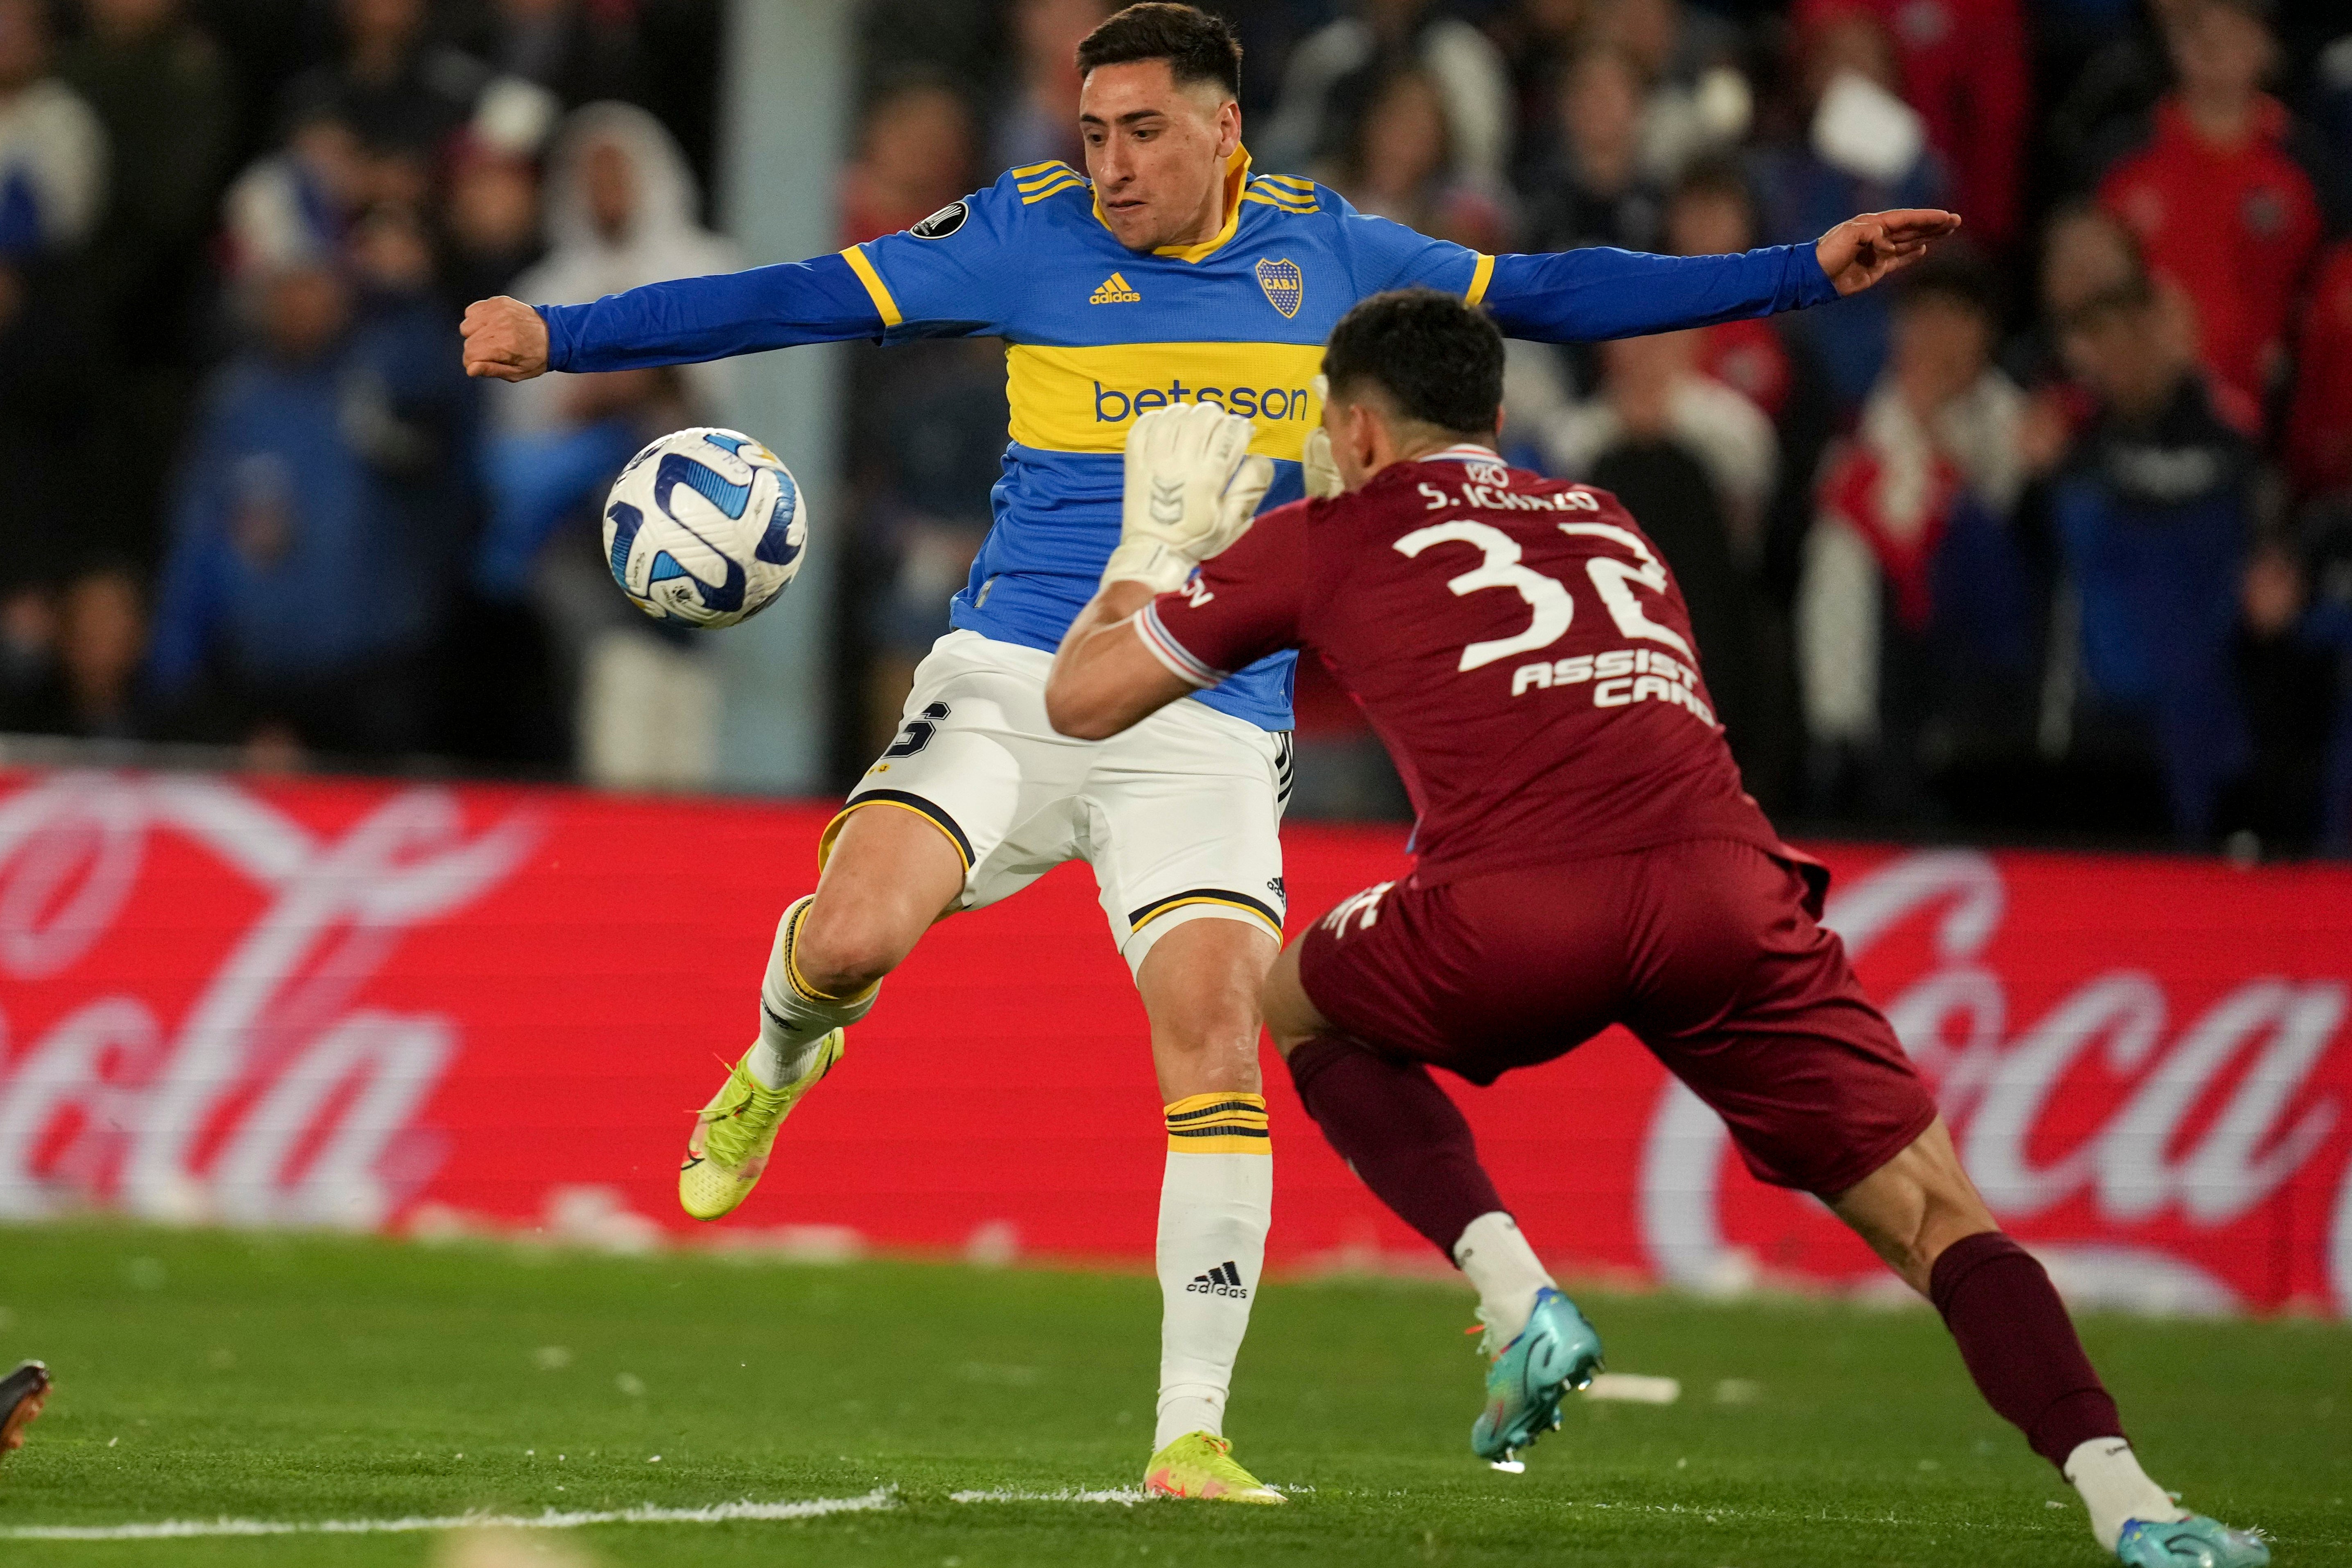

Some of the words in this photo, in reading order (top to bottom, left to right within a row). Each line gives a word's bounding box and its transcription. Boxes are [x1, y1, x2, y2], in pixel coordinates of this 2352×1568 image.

[1089, 291, 1141, 305] adidas
[1263, 278, 1297, 290] CABJ
[1094, 379, 1308, 422] betsson
[1417, 482, 1461, 510] S.
[1392, 519, 1695, 672] 32
[1511, 648, 1698, 697] ASSIST
[1186, 1281, 1247, 1299] adidas
